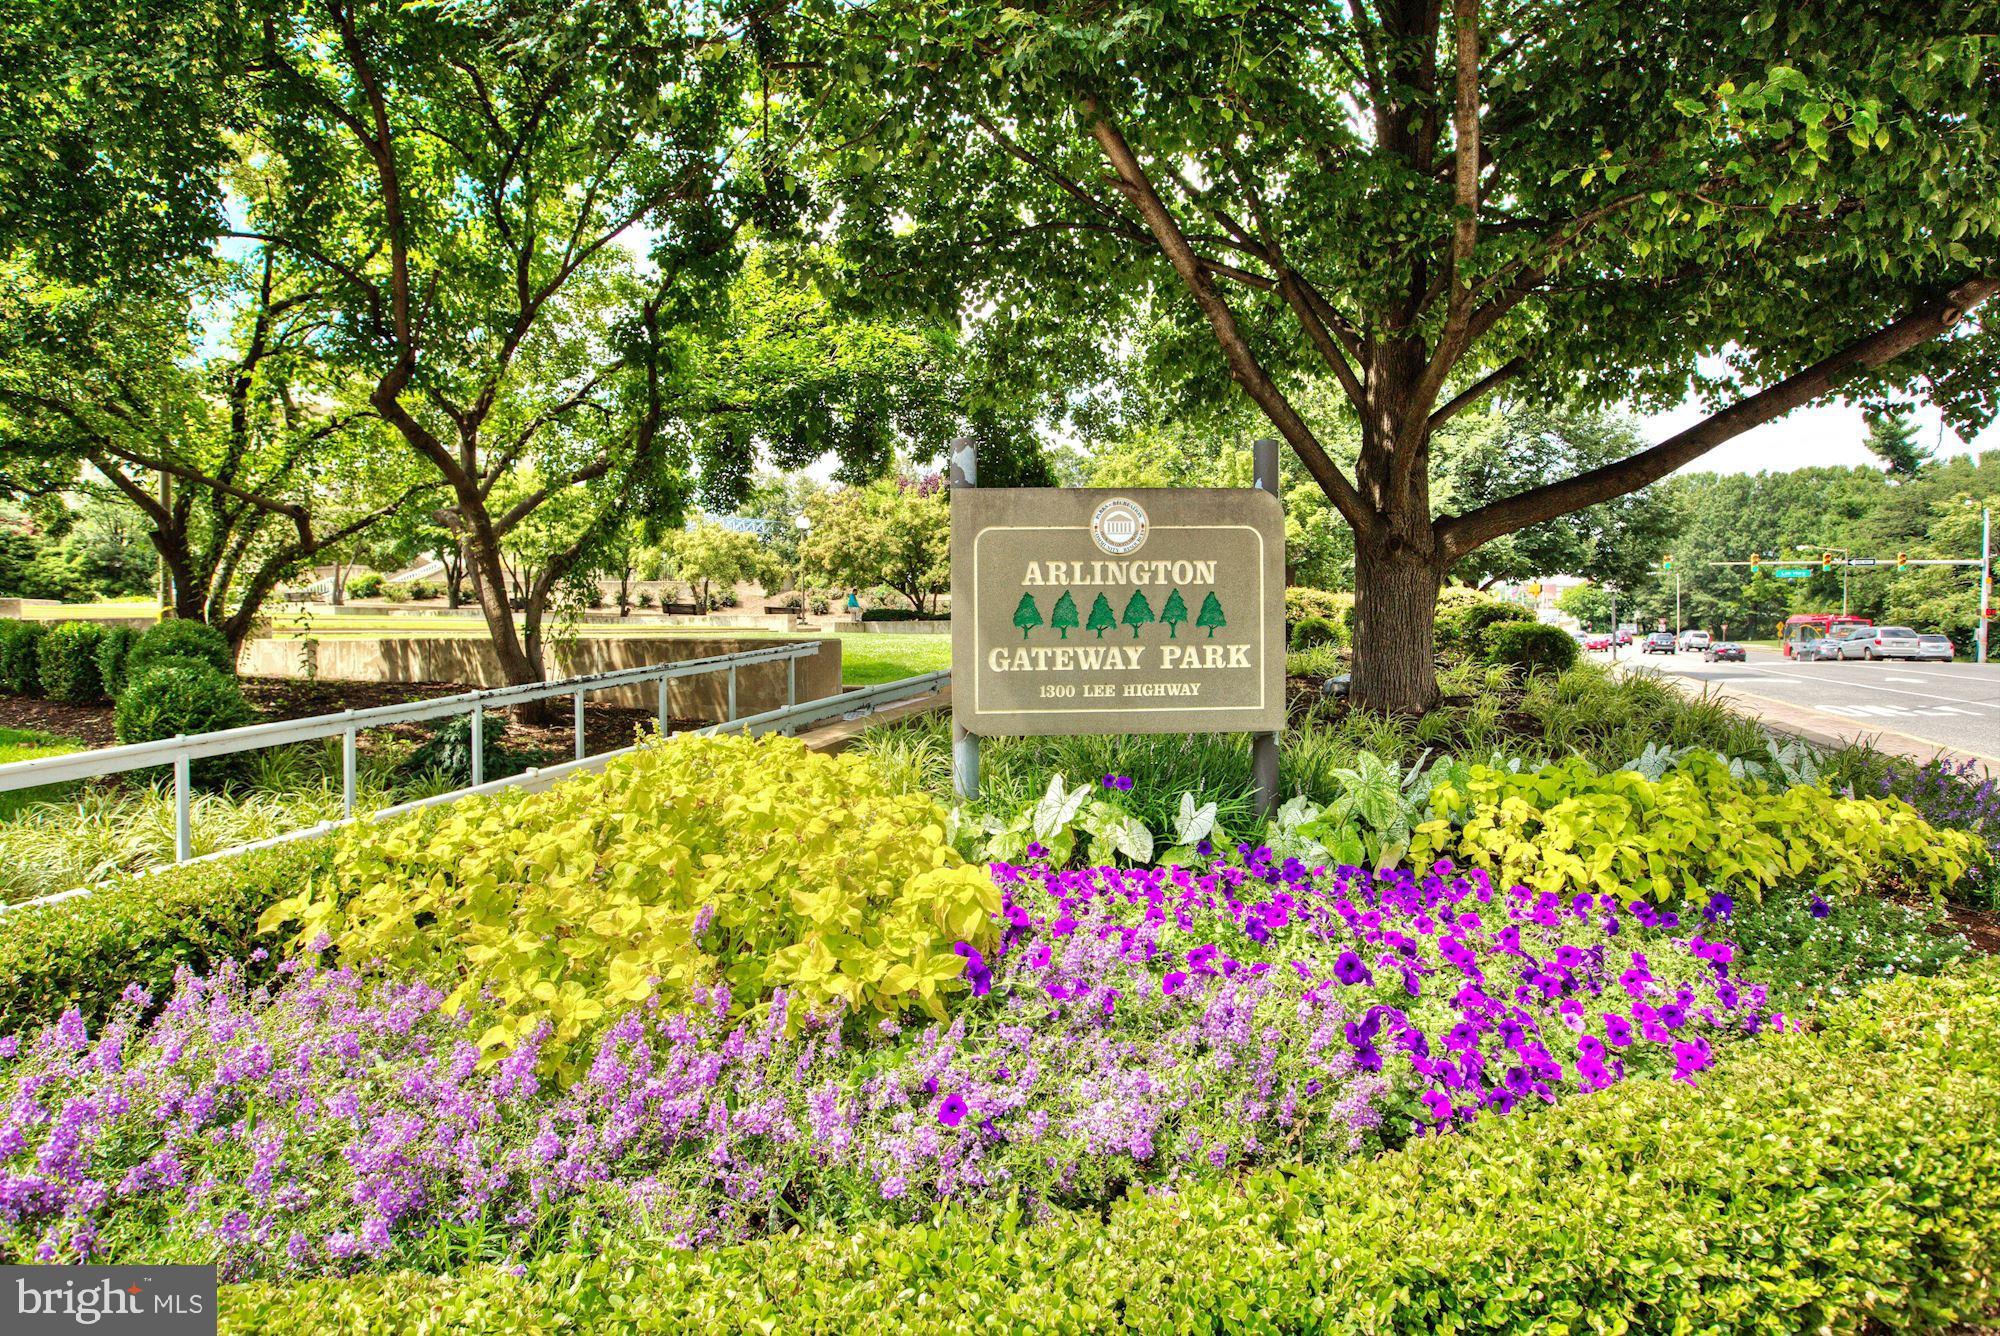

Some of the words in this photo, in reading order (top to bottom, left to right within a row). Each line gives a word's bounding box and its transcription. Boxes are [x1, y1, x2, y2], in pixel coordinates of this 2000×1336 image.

[1021, 560, 1217, 586] ARLINGTON
[988, 646, 1145, 672] GATEWAY
[1160, 644, 1251, 669] PARK
[1040, 685, 1075, 698] 1300
[1083, 685, 1115, 697] LEE
[1123, 683, 1201, 697] HIGHWAY
